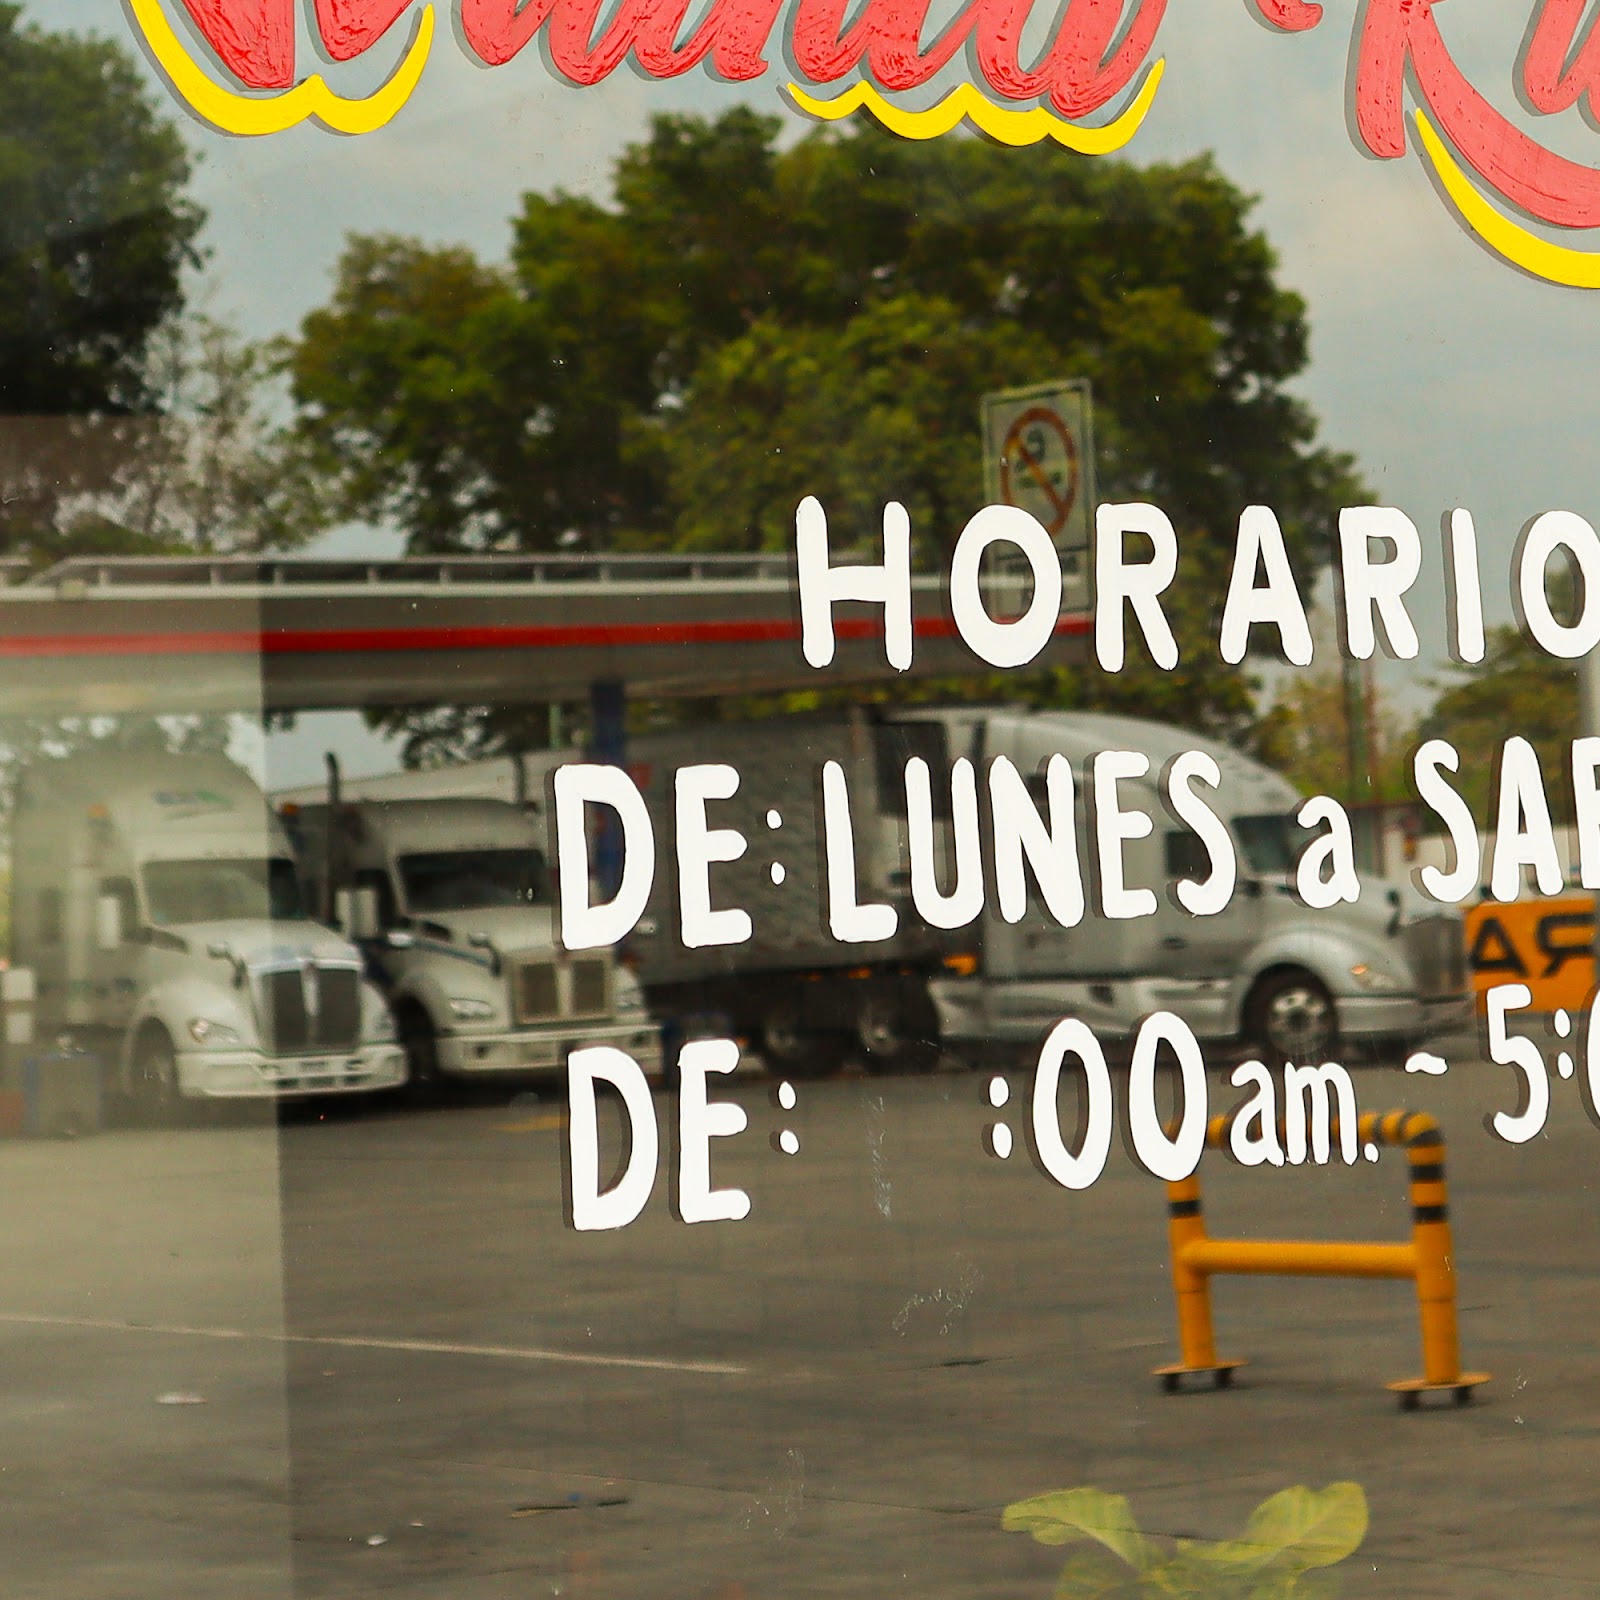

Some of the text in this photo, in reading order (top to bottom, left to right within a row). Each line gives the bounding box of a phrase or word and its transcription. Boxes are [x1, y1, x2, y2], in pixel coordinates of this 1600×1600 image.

[553, 763, 786, 951] DE:
[822, 749, 1237, 943] LUNES
[1296, 795, 1362, 909] a
[567, 1038, 800, 1231] DE:
